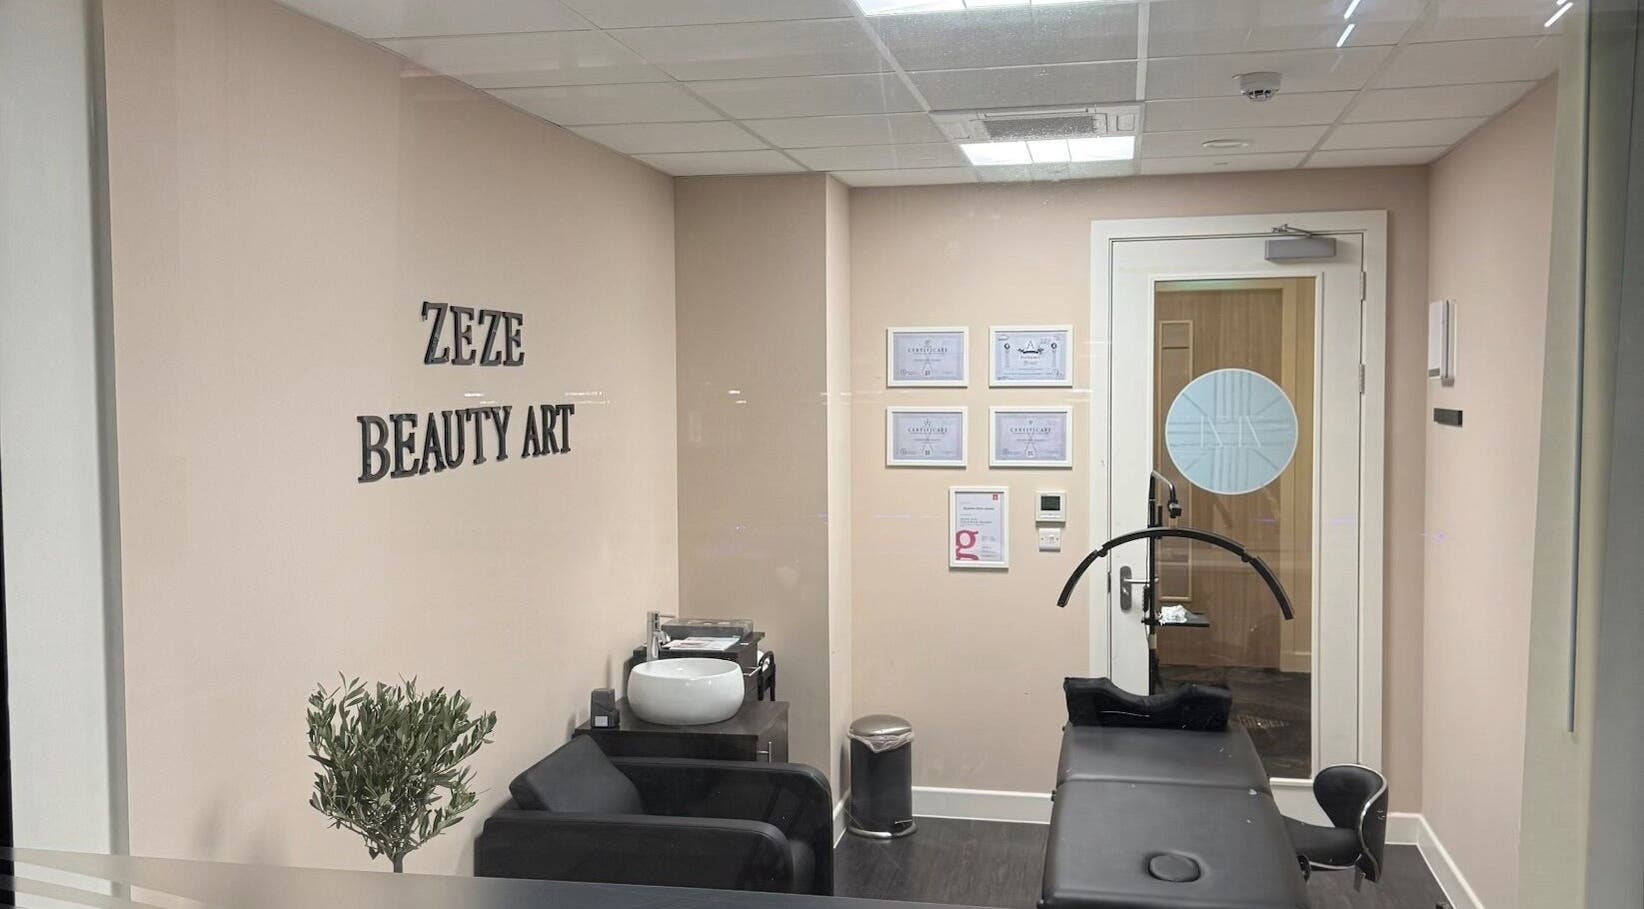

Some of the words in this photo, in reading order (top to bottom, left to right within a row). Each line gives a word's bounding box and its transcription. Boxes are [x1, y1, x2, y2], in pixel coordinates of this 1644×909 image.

[421, 301, 525, 367] ZEZE
[357, 405, 513, 484] BEAUTY
[521, 403, 575, 459] ART
